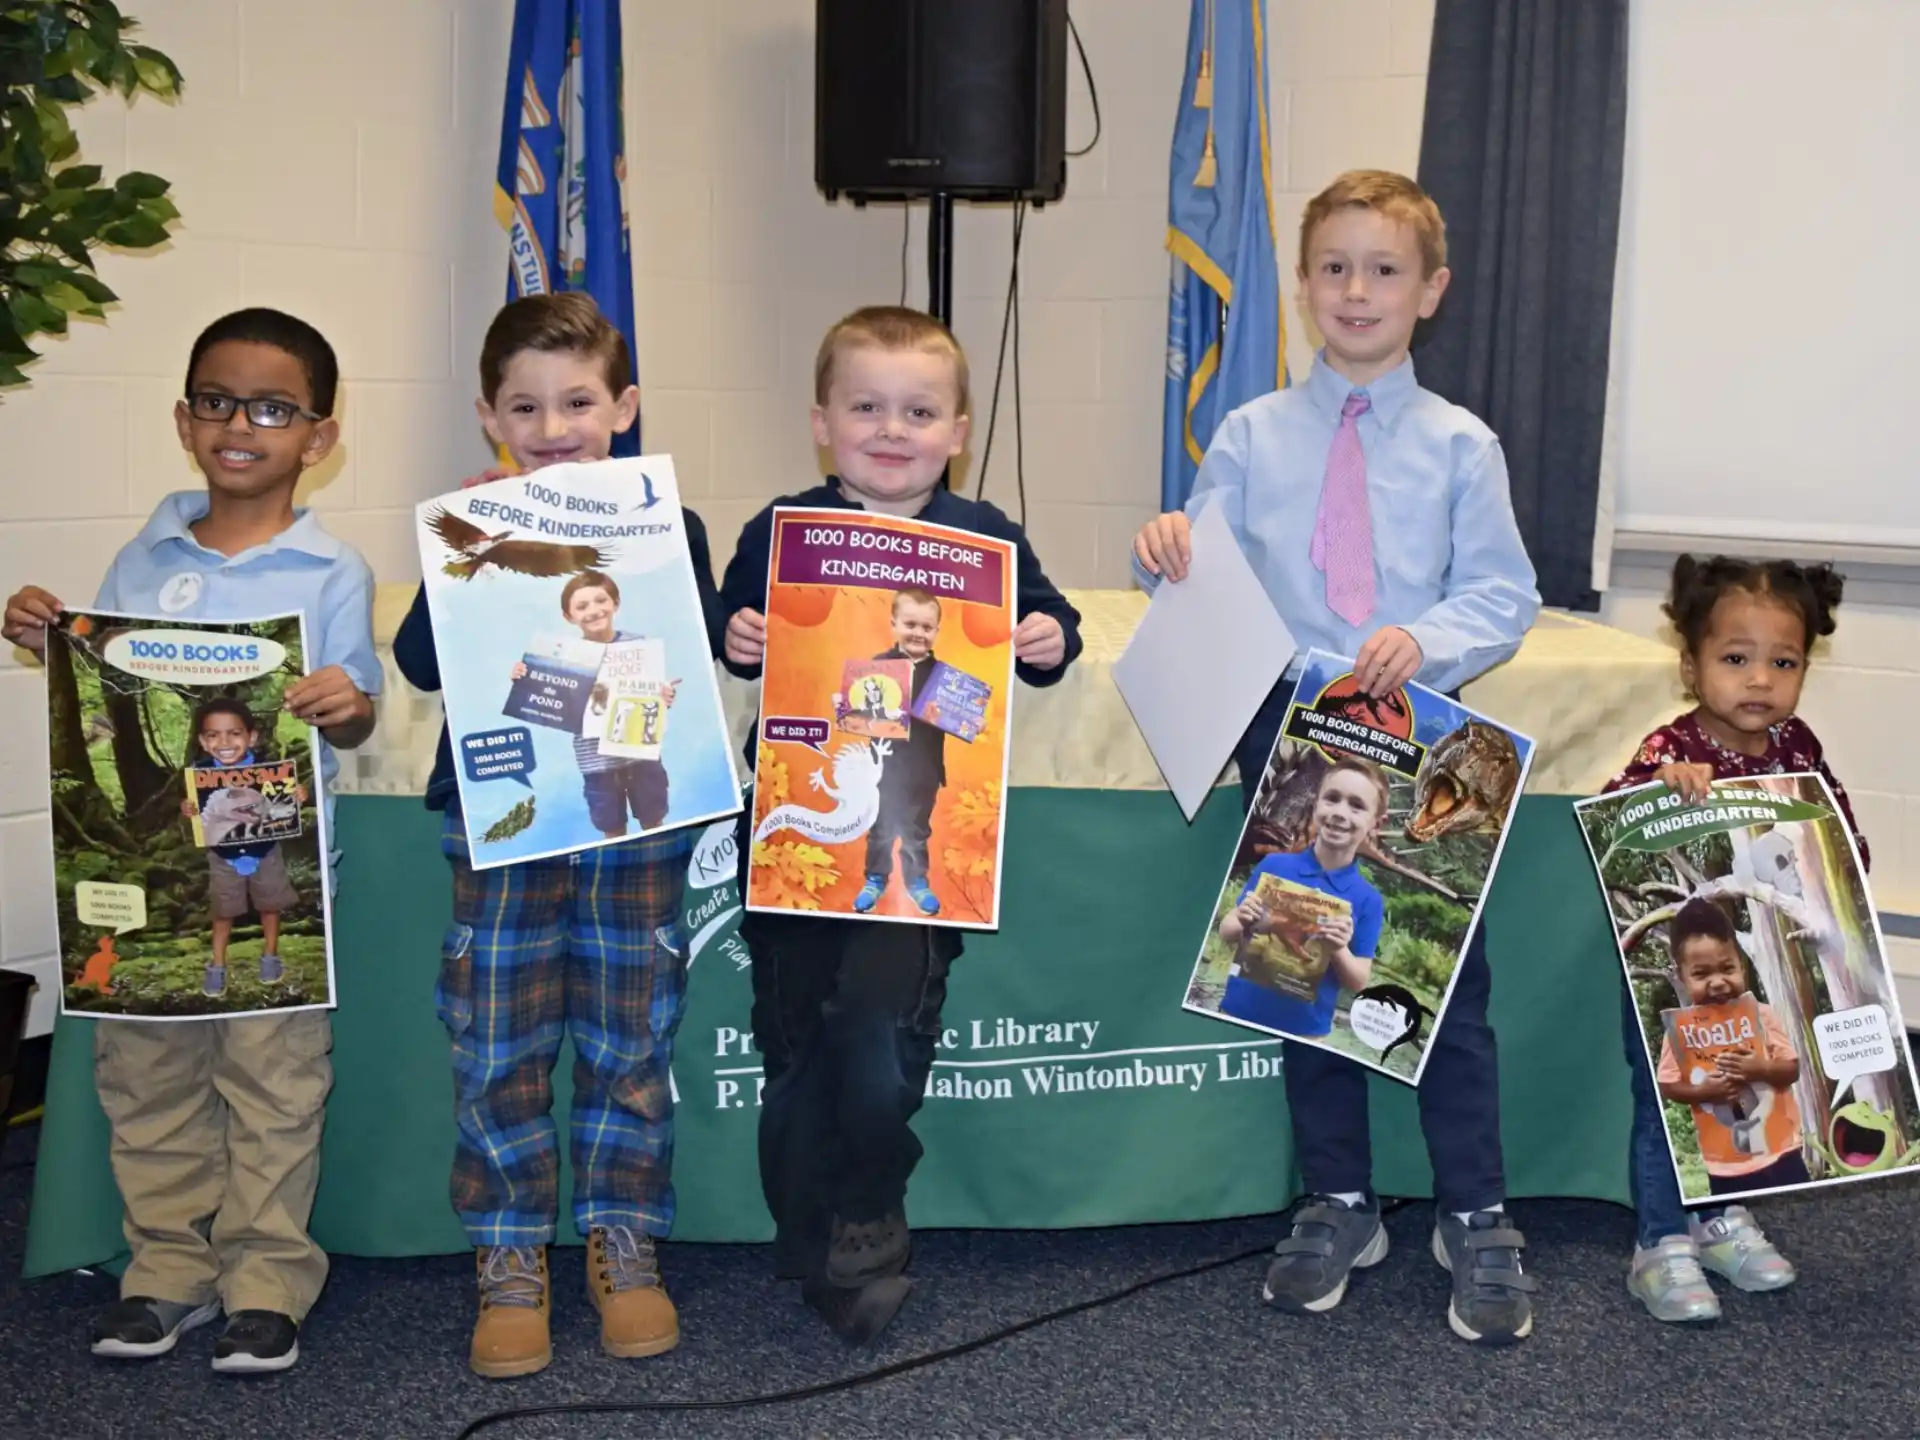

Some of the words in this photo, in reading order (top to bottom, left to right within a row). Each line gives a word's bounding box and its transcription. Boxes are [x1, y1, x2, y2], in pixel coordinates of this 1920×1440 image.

[524, 481, 560, 507] 1000
[566, 496, 618, 515] BOOKS
[468, 498, 534, 529] BEFORE
[538, 518, 672, 538] KINDERGARTEN
[804, 529, 844, 546] 1000
[850, 531, 912, 554] BOOKS
[918, 541, 983, 568] BEFORE
[820, 559, 964, 591] KINDERGARTEN
[129, 640, 177, 659] 1000
[183, 644, 259, 661] BOOKS
[130, 662, 168, 673] BEFORE
[173, 664, 260, 675] KINDERGARTEN
[530, 670, 578, 689] BEYOND
[529, 694, 563, 710] POND
[466, 738, 485, 749] WE
[486, 736, 506, 746] DID
[508, 732, 524, 743] IT!
[771, 725, 786, 736] WE
[788, 726, 806, 736] DID
[1300, 710, 1325, 724] 1000
[1326, 717, 1368, 737] BOOKS
[1369, 730, 1416, 756] BEFORE
[494, 750, 522, 761] BOOKS
[1308, 727, 1398, 765] KINDERGARTEN
[476, 762, 524, 776] COMPLETED
[261, 777, 296, 796] A-Z
[1619, 802, 1654, 828] 1000
[1722, 790, 1793, 807] BEFORE
[765, 814, 783, 832] 1000
[785, 814, 811, 829] Books
[1642, 806, 1778, 840] KINDERGARTEN
[686, 887, 729, 929] Create
[718, 938, 752, 972] Play
[969, 1017, 1100, 1050] Library
[1824, 1022, 1840, 1033] WE
[1843, 1018, 1862, 1029] DID
[1865, 1014, 1877, 1024] IT!
[1850, 1032, 1882, 1046] BOOKS
[1832, 1046, 1884, 1063] COMPLETED
[715, 1080, 744, 1109] P.
[1021, 1058, 1208, 1096] Wintonbury
